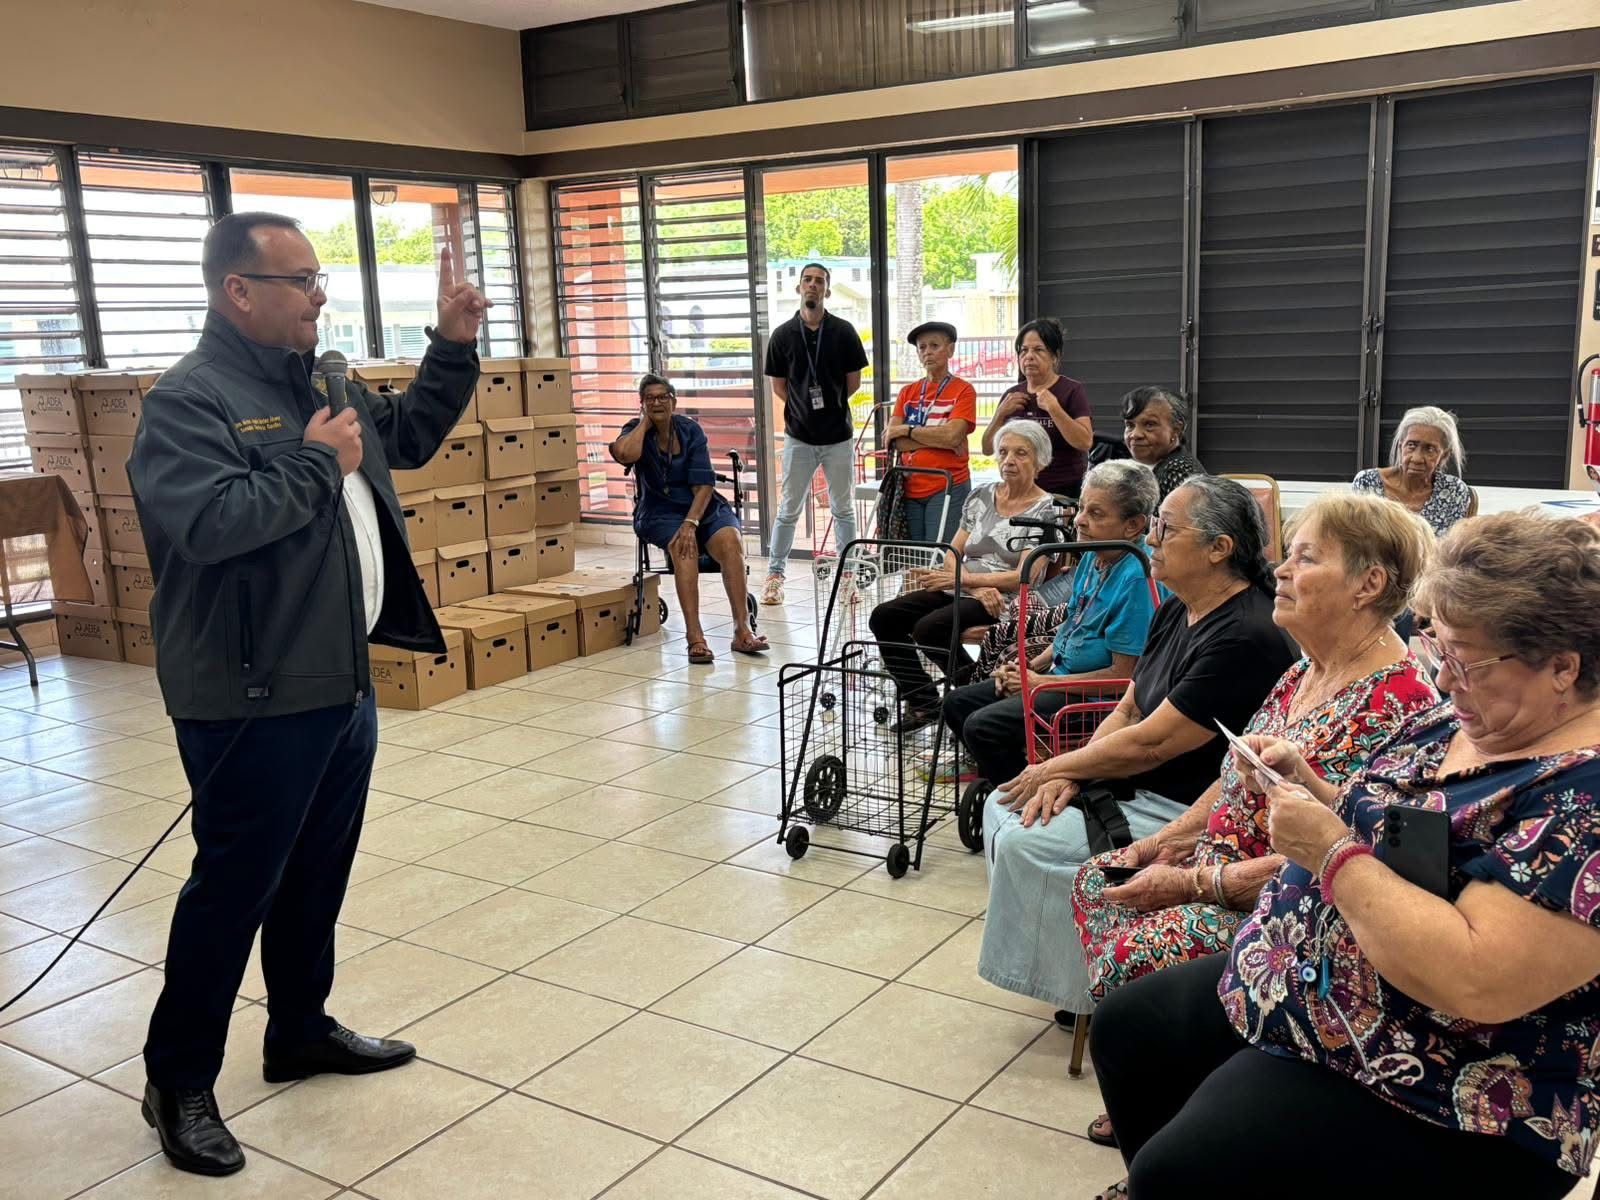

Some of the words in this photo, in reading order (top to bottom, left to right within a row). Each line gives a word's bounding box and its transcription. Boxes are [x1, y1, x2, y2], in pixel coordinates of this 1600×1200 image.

[46, 396, 63, 407] ADEA
[110, 398, 128, 409] ADEA
[56, 455, 73, 466] ADEA
